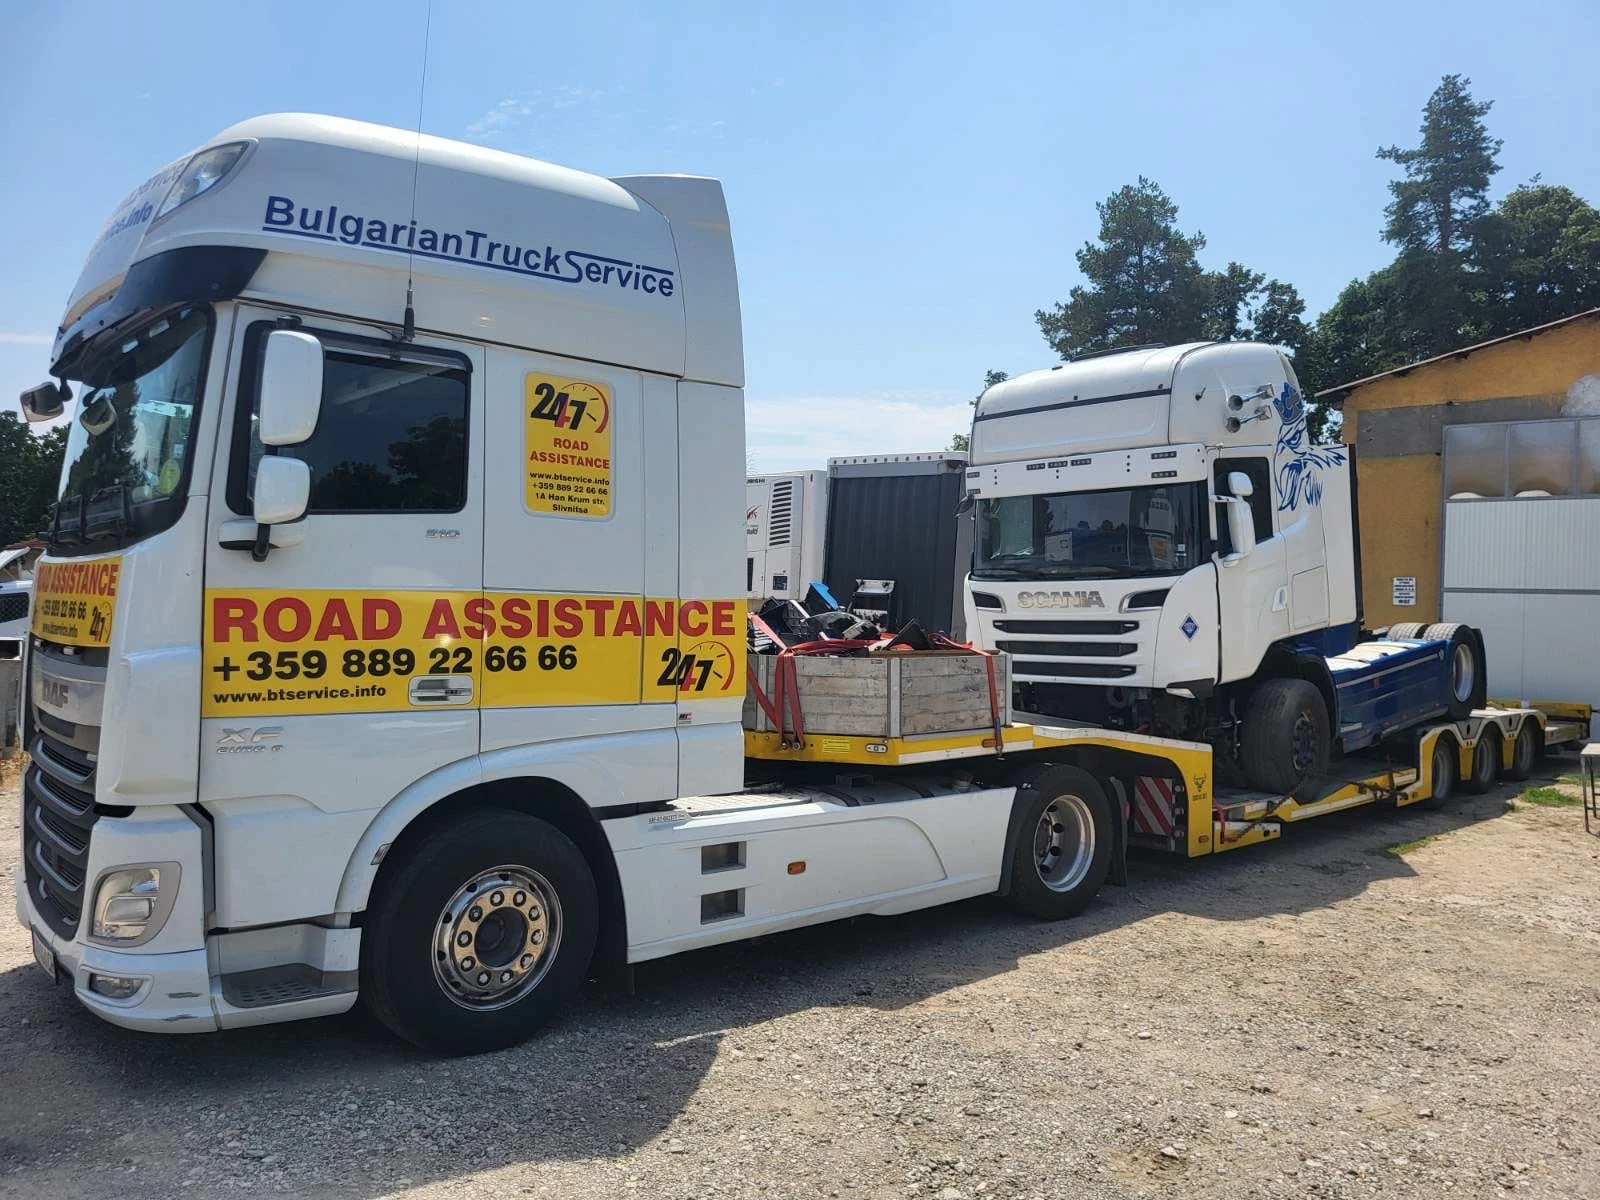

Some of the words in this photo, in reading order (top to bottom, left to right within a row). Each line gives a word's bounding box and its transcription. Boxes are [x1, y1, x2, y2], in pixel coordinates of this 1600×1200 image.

[263, 196, 674, 297] BulgarianTruckService
[553, 437, 589, 452] ROAD
[530, 450, 610, 470] ASSISTANCE
[529, 472, 610, 486] www.btservice.info
[533, 482, 554, 491] +359
[556, 483, 572, 492] 889
[574, 485, 584, 494] 22
[586, 486, 597, 495] 66
[598, 488, 608, 496] 66
[535, 492, 546, 500] 1A
[548, 493, 566, 502] Han
[567, 494, 590, 504] Krum
[552, 503, 589, 514] Slivnitsa
[50, 563, 119, 597] ASSISTANCE
[1017, 590, 1105, 609] SCANIA
[213, 597, 402, 643] ROAD
[422, 598, 736, 640] ASSISTANCE
[213, 650, 328, 682] +359
[342, 648, 415, 678] 889
[428, 647, 473, 675] 22
[484, 645, 527, 672] 66
[538, 644, 578, 671] 66
[43, 679, 69, 708] DAF
[213, 684, 387, 704] www.btservice.info
[217, 726, 285, 743] XF
